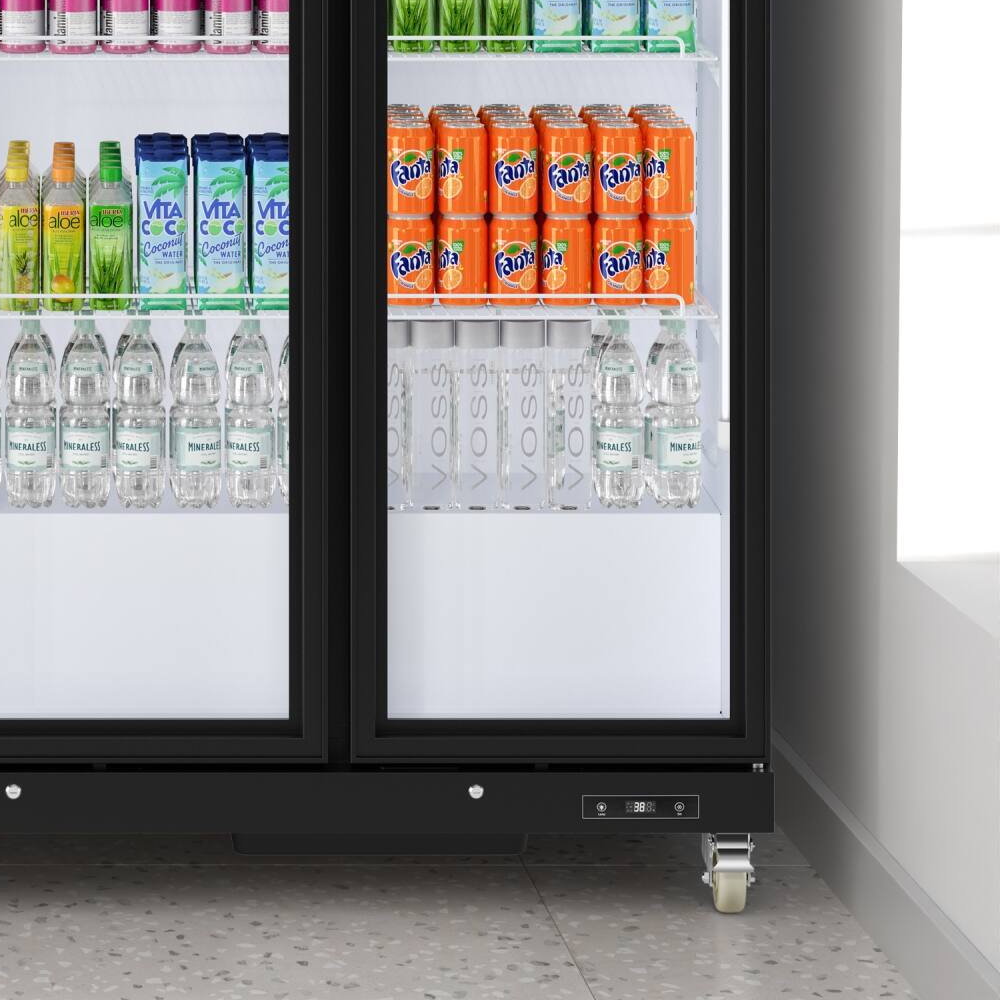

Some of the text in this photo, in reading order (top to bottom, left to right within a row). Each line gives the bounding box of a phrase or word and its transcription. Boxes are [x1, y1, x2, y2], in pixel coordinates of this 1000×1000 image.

[390, 157, 431, 187] Fanta
[495, 157, 535, 187] Fanta
[548, 160, 590, 191] Fanta
[600, 160, 640, 191] Fanta
[9, 212, 38, 227] aloe
[49, 212, 80, 229] aloe
[90, 211, 123, 228] aloe
[143, 199, 183, 219] VITA
[202, 199, 241, 219] VITA
[142, 219, 186, 236] COCO
[200, 219, 244, 236] COCO
[143, 232, 184, 258] Coconut
[202, 232, 242, 258] Coconut
[390, 248, 431, 279] Fanta
[495, 248, 535, 279] Fanta
[600, 248, 640, 279] Fanta
[430, 363, 447, 489] VOSS
[470, 363, 488, 489] VOSS
[521, 363, 538, 489] VOSS
[568, 363, 585, 489] VOSS
[634, 802, 645, 812] 38
